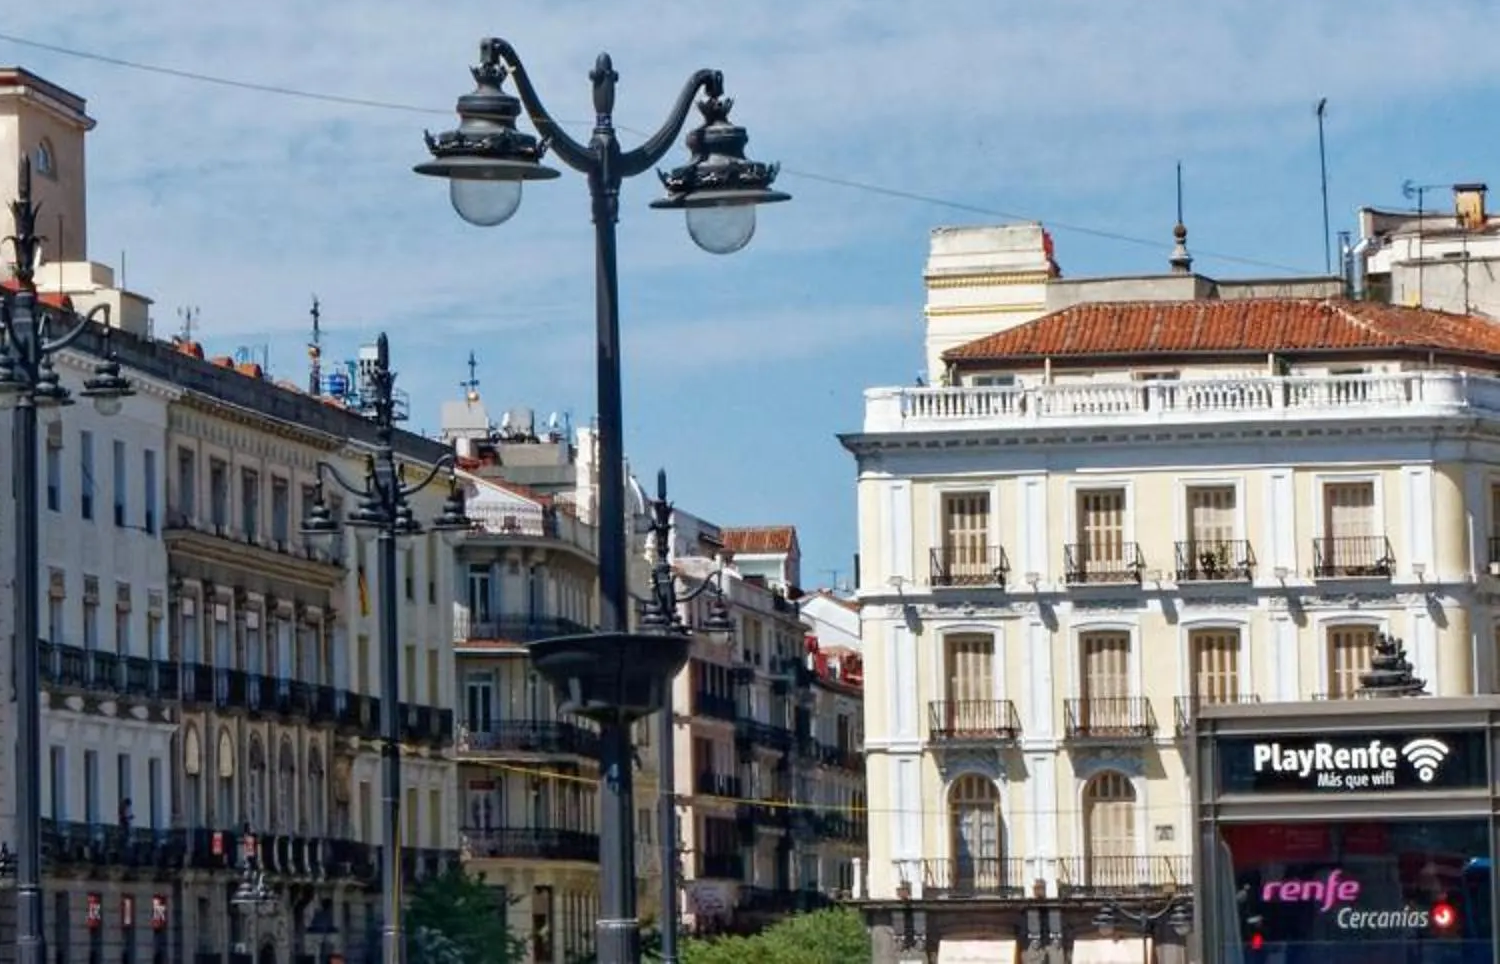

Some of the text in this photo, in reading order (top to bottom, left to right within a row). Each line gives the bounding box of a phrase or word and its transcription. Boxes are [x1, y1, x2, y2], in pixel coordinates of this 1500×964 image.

[1254, 740, 1397, 777] PlayRenfe
[1317, 771, 1395, 789] Más que wifi
[1262, 868, 1360, 912] renfe
